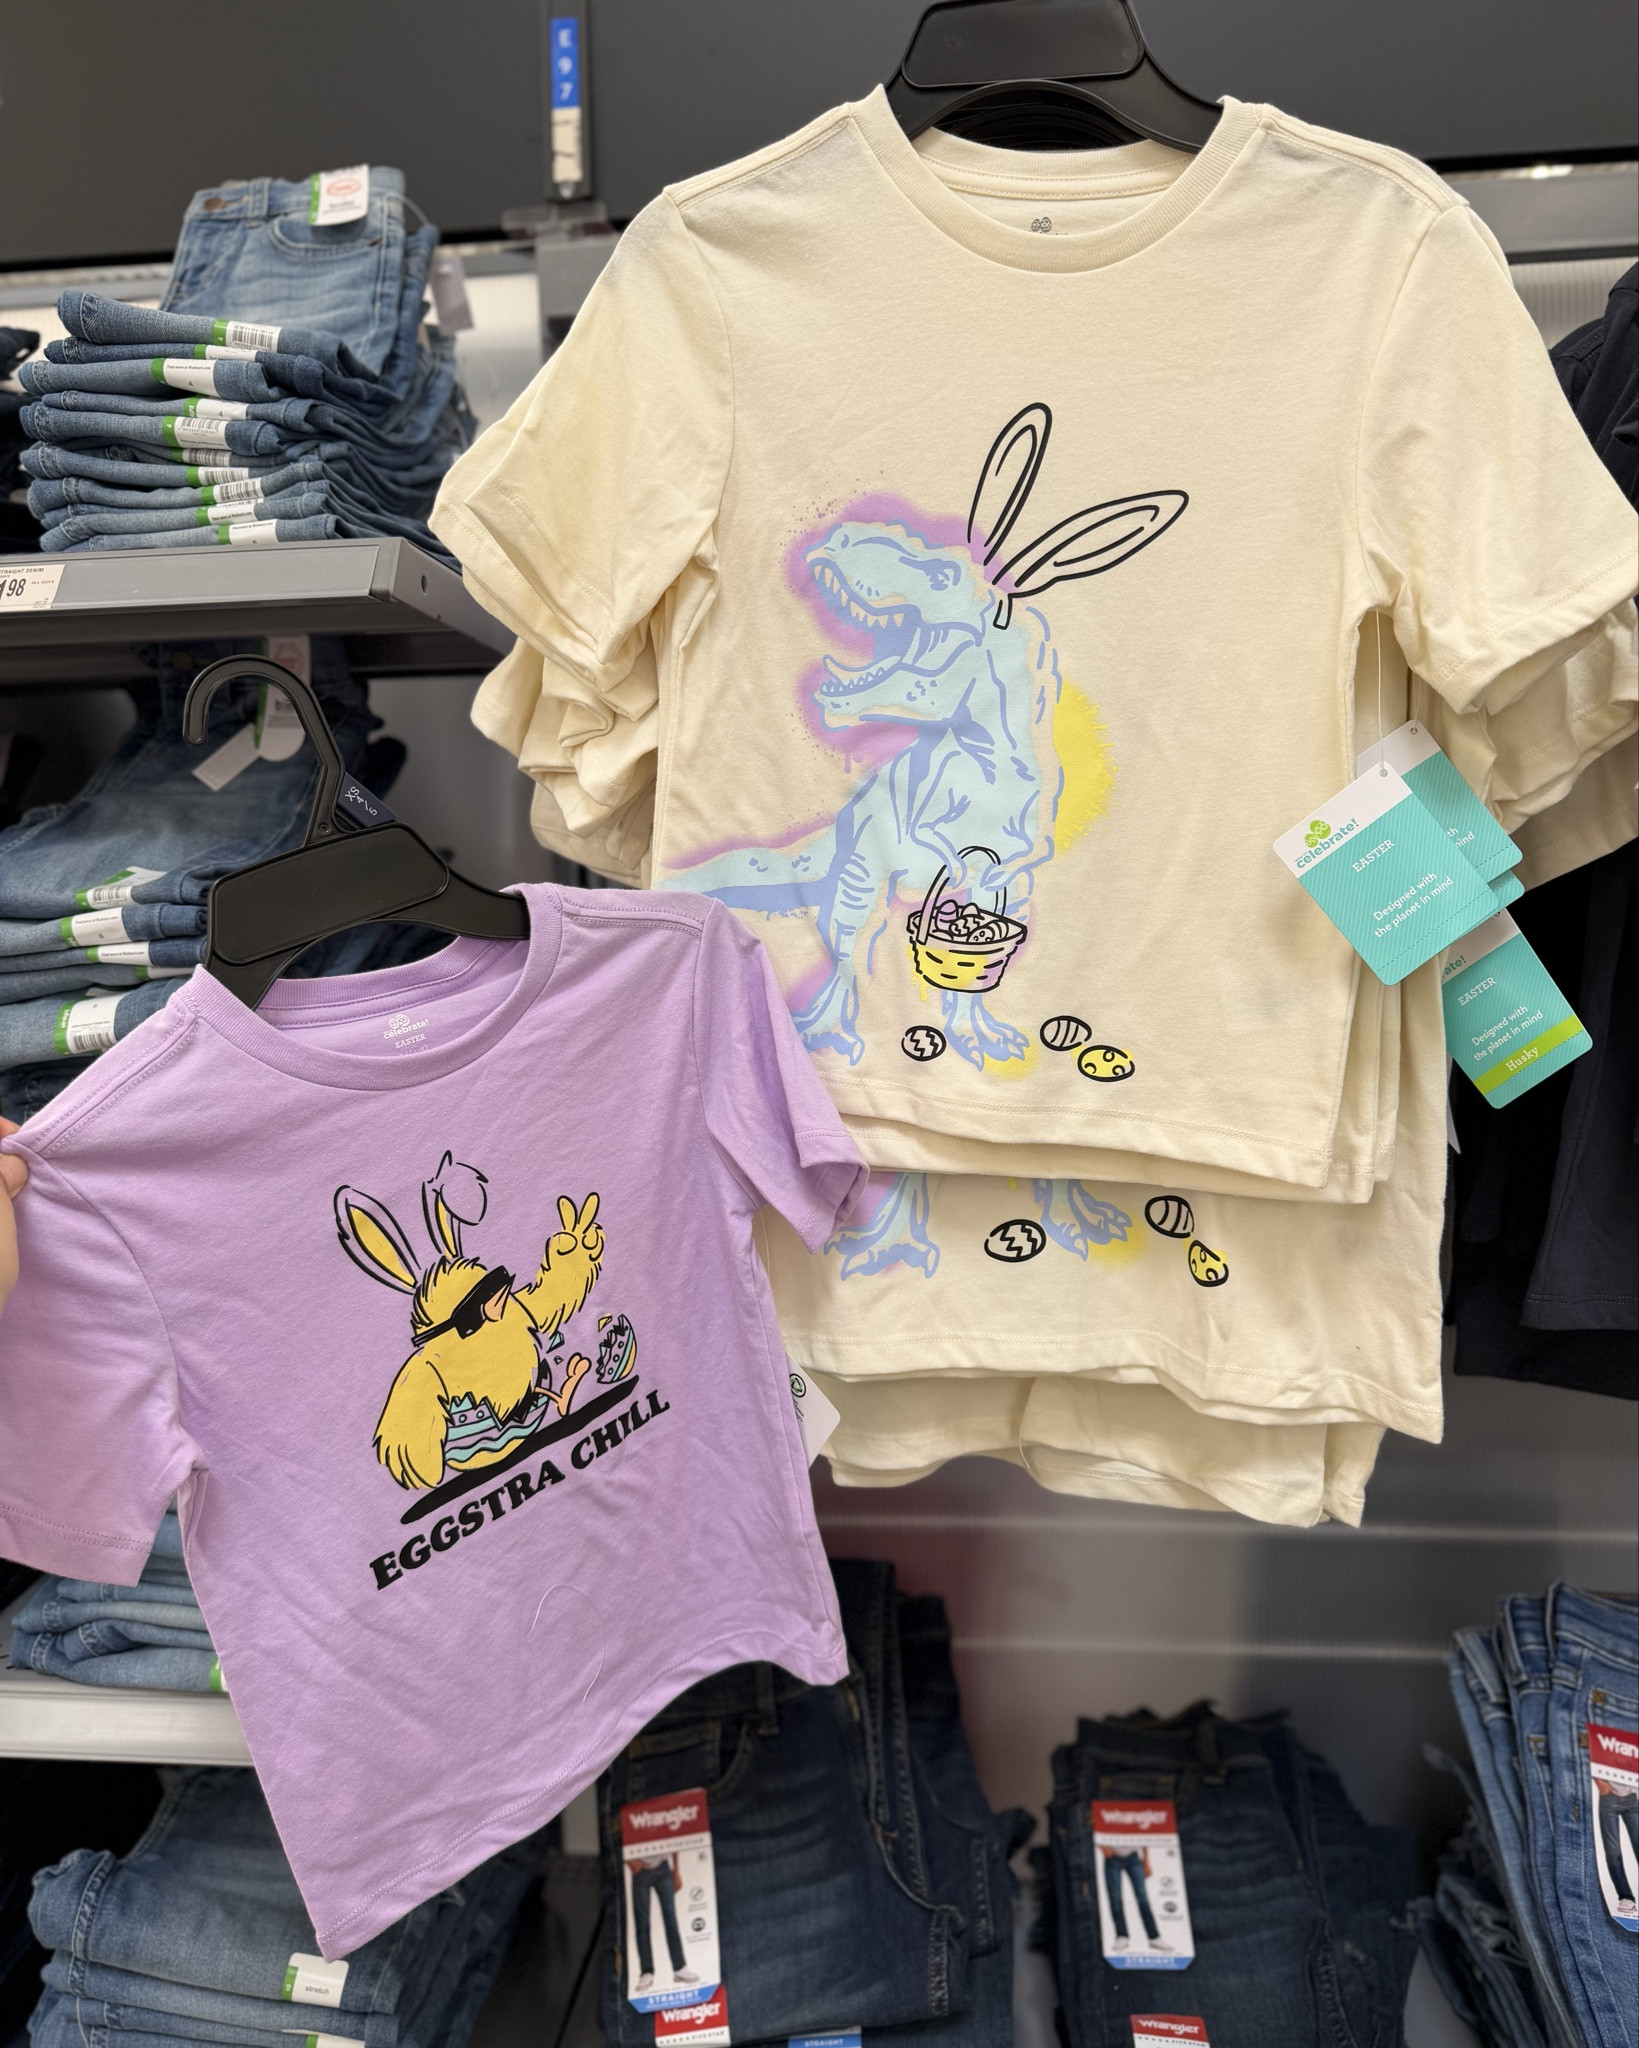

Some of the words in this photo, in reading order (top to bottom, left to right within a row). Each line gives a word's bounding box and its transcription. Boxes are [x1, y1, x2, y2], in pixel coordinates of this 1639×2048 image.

[344, 786, 360, 802] XS
[1296, 818, 1359, 868] celebrate!
[1352, 839, 1395, 873] EASTER
[1373, 886, 1417, 921] Designed
[1416, 872, 1437, 889] with
[1374, 923, 1392, 938] the
[1392, 901, 1422, 928] planet
[1420, 894, 1431, 905] in
[1430, 876, 1453, 897] mind
[1458, 976, 1496, 1006] EASTER
[383, 1018, 430, 1040] celebrate!
[1472, 1017, 1509, 1046] Designed
[1508, 1005, 1528, 1021] with
[1473, 1049, 1488, 1061] the
[1487, 1033, 1512, 1055] planet
[1510, 1027, 1521, 1036] in
[1521, 1010, 1543, 1030] mind
[394, 1033, 427, 1048] EASTER
[1505, 1046, 1539, 1072] Husky
[369, 1459, 566, 1591] EGGSTRA
[570, 1389, 670, 1470] CHILL
[629, 1804, 699, 1831] Wrangler
[1100, 1808, 1167, 1830] Wrangler
[305, 1985, 330, 1995] stretch
[648, 1990, 700, 2005] STRAIGHT
[661, 2002, 721, 2025] Wrangler
[1137, 2019, 1200, 2035] Wrangler
[804, 2038, 844, 2047] STRAIGHT
